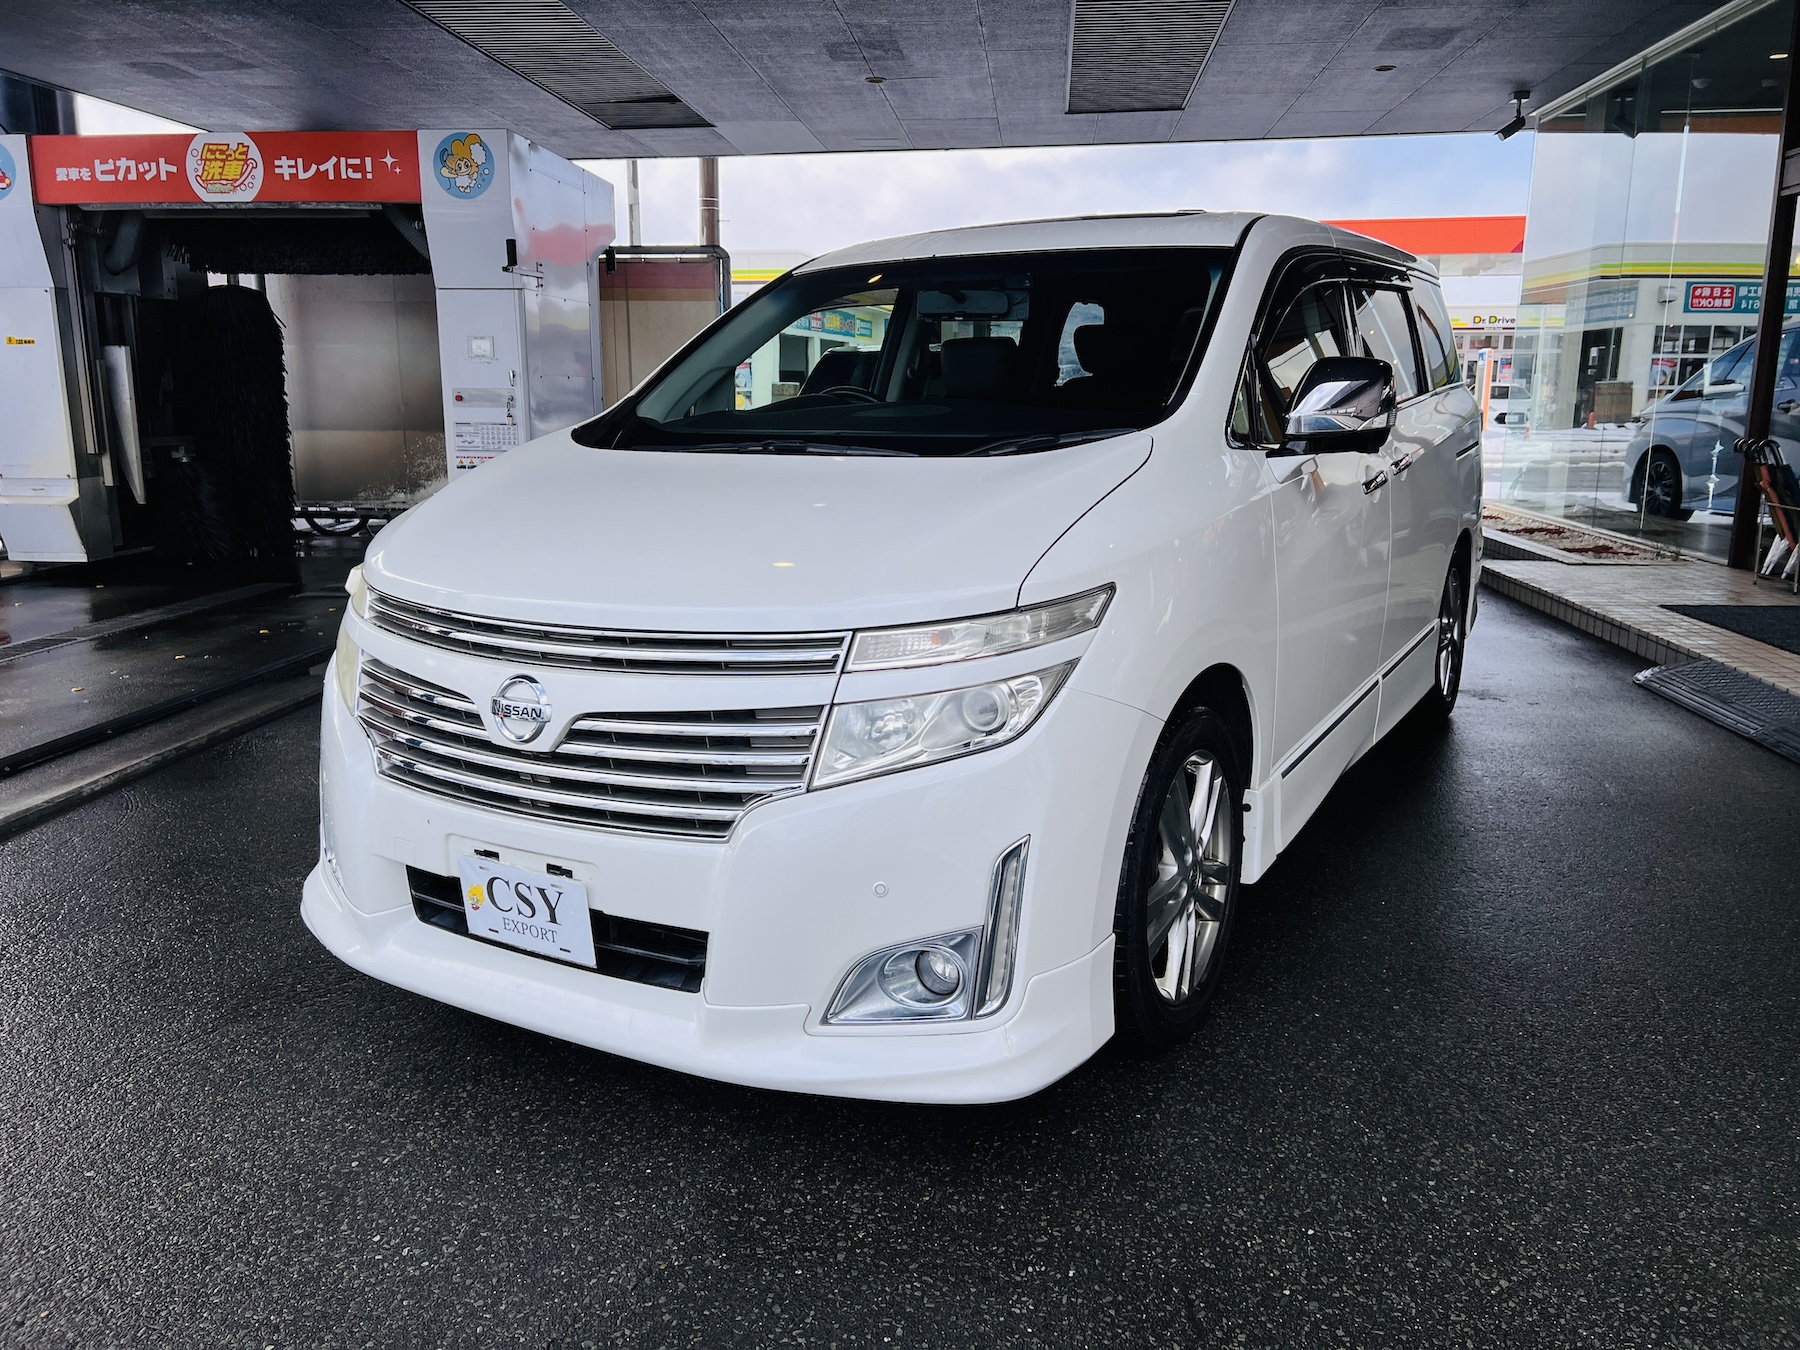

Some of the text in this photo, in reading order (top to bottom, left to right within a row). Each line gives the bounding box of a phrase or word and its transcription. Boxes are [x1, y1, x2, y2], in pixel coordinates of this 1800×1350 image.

[201, 144, 249, 160] にこっと
[201, 160, 245, 181] 洗車
[274, 155, 373, 181] キレイに!
[1488, 315, 1516, 324] Drive
[492, 699, 542, 718] NISSAN
[486, 876, 564, 926] CSY
[501, 917, 558, 943] EXPORT
